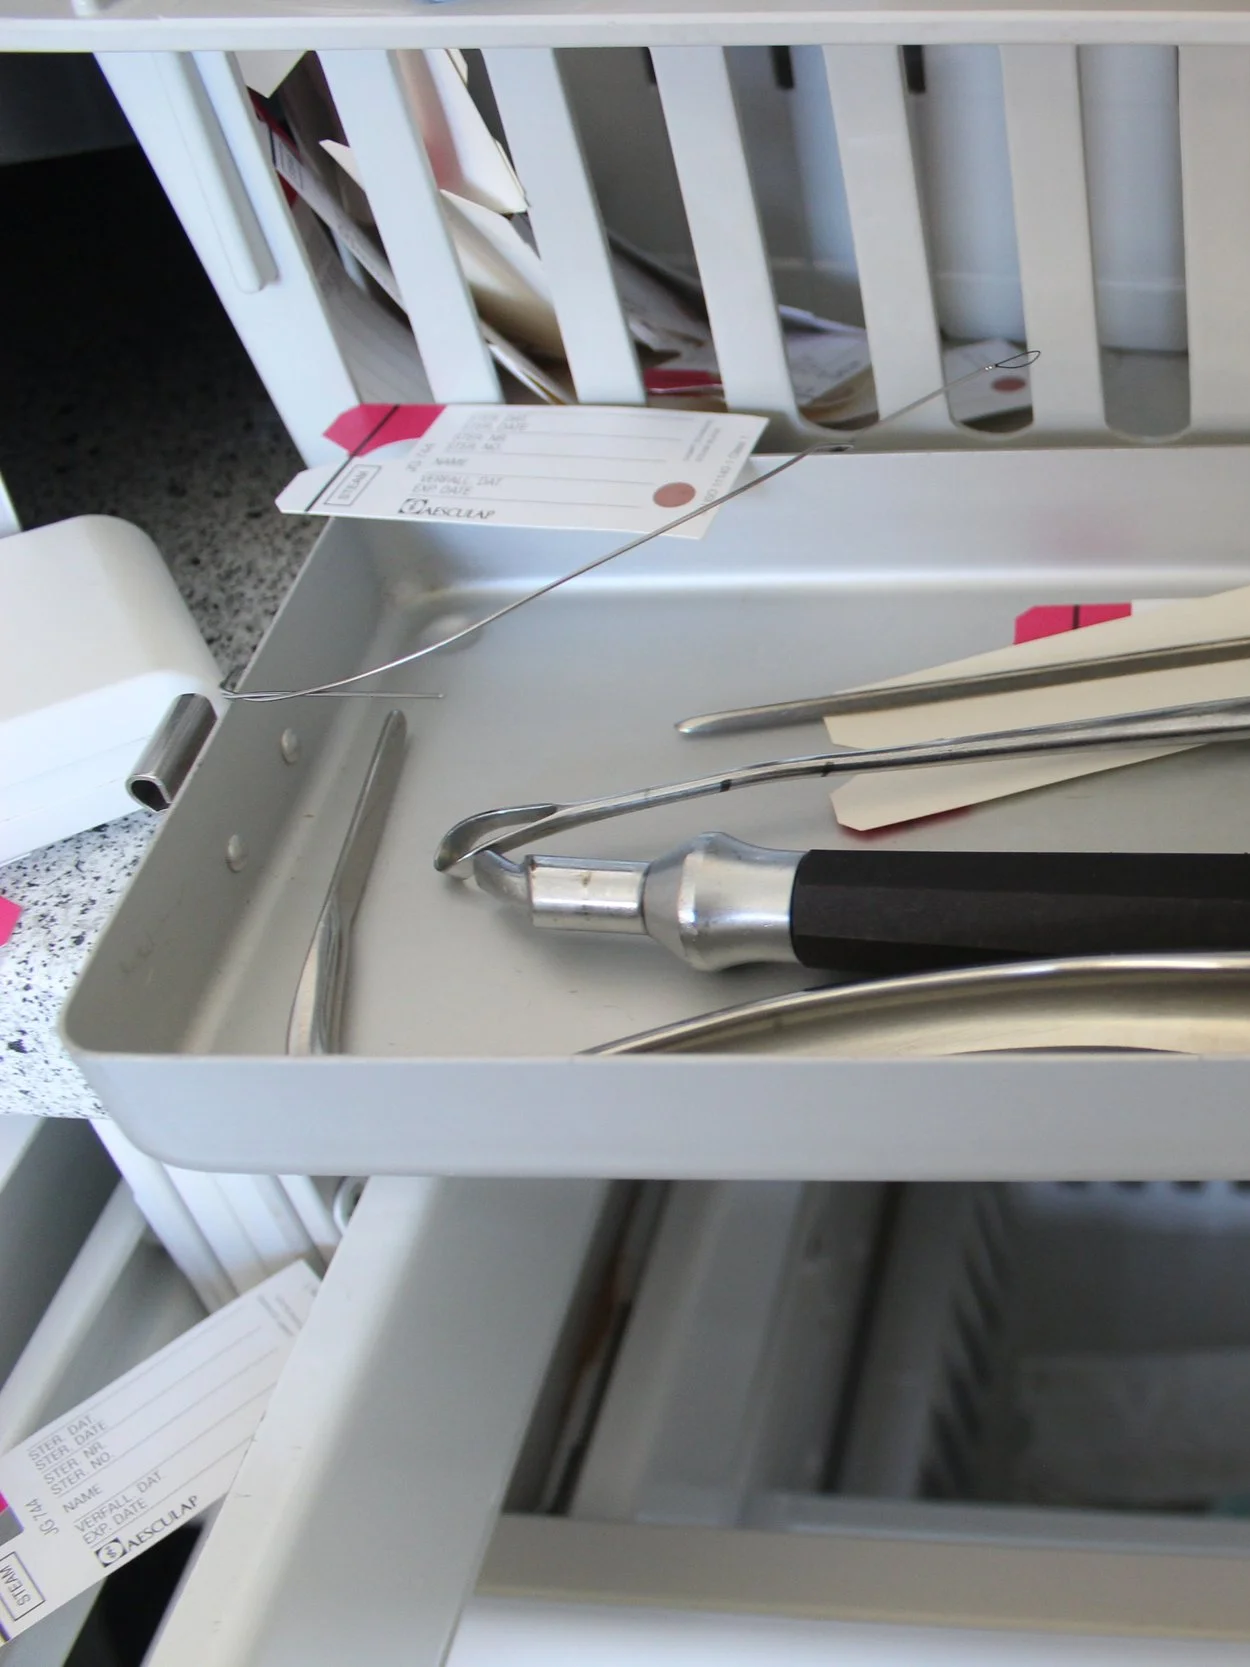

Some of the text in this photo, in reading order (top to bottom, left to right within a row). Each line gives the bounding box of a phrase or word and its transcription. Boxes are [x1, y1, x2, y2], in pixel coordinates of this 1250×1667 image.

[421, 506, 496, 520] AESCULAP
[74, 1421, 106, 1446] DATE
[62, 1483, 102, 1513] NAME
[112, 1498, 148, 1525] DATE
[39, 1518, 60, 1535] JG
[126, 1495, 198, 1552] AESCULAP
[0, 1564, 31, 1606] STEAM
